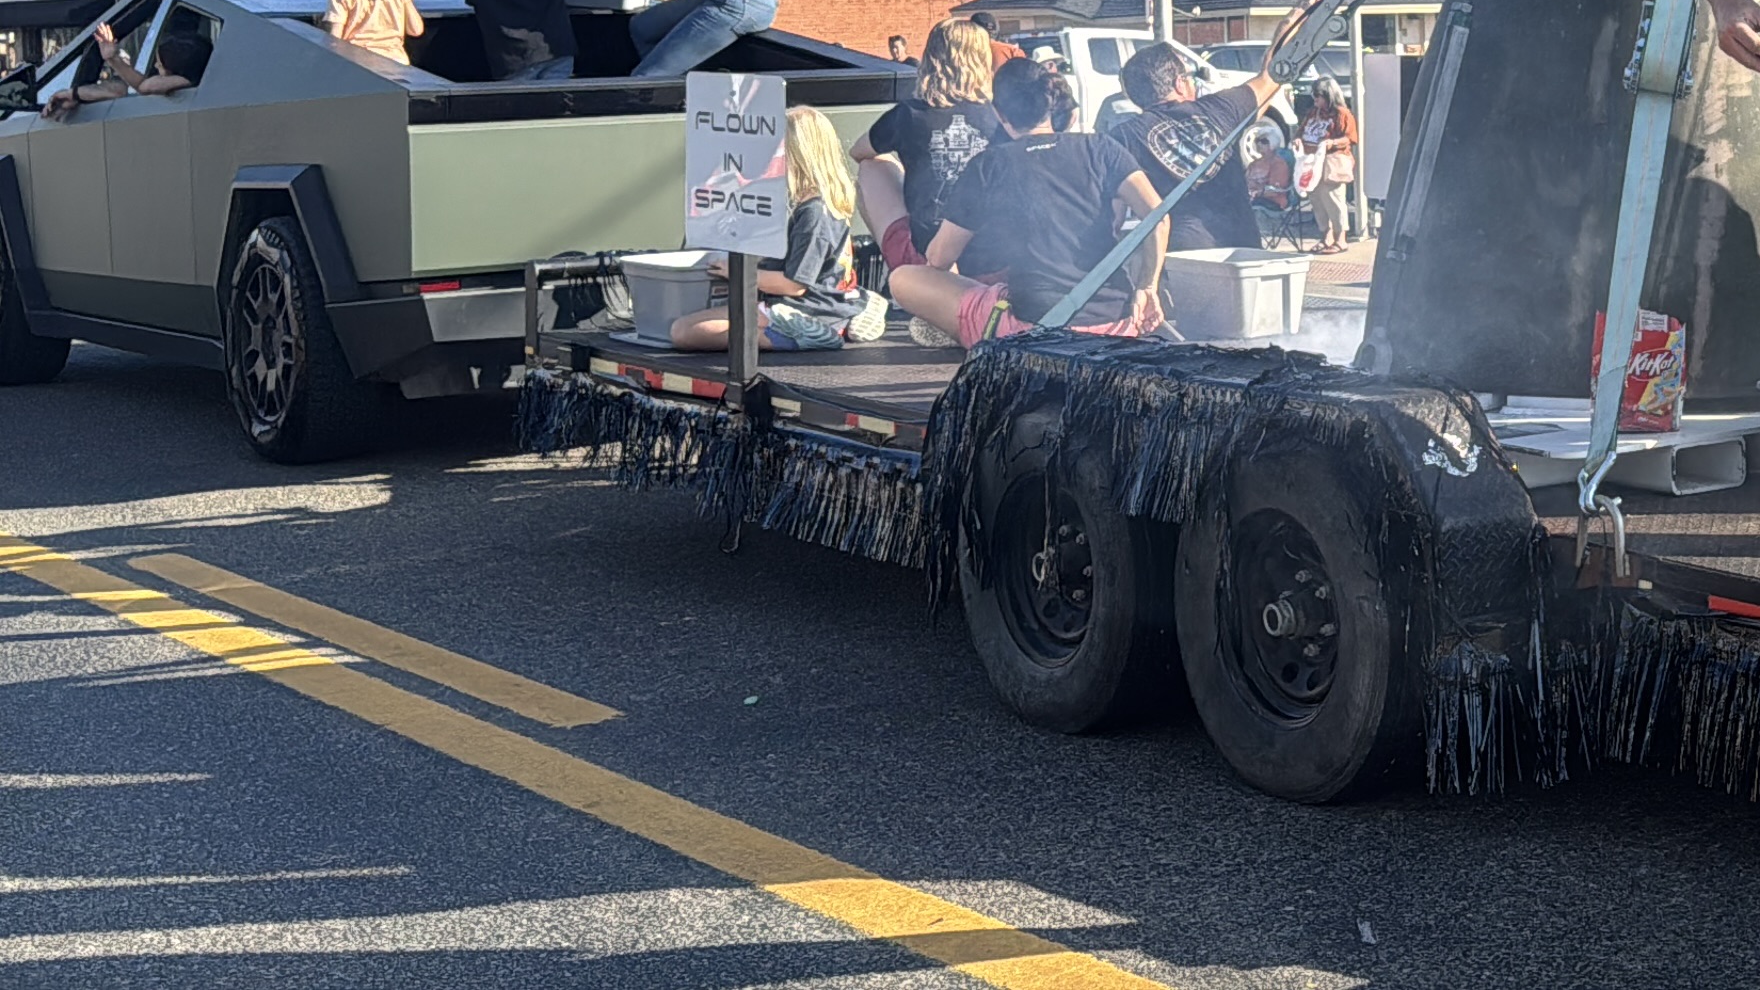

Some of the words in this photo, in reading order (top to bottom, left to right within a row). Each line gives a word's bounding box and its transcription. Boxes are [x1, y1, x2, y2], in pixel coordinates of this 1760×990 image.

[695, 111, 776, 136] FLOWN
[723, 152, 743, 173] IN
[694, 188, 772, 217] SPACE
